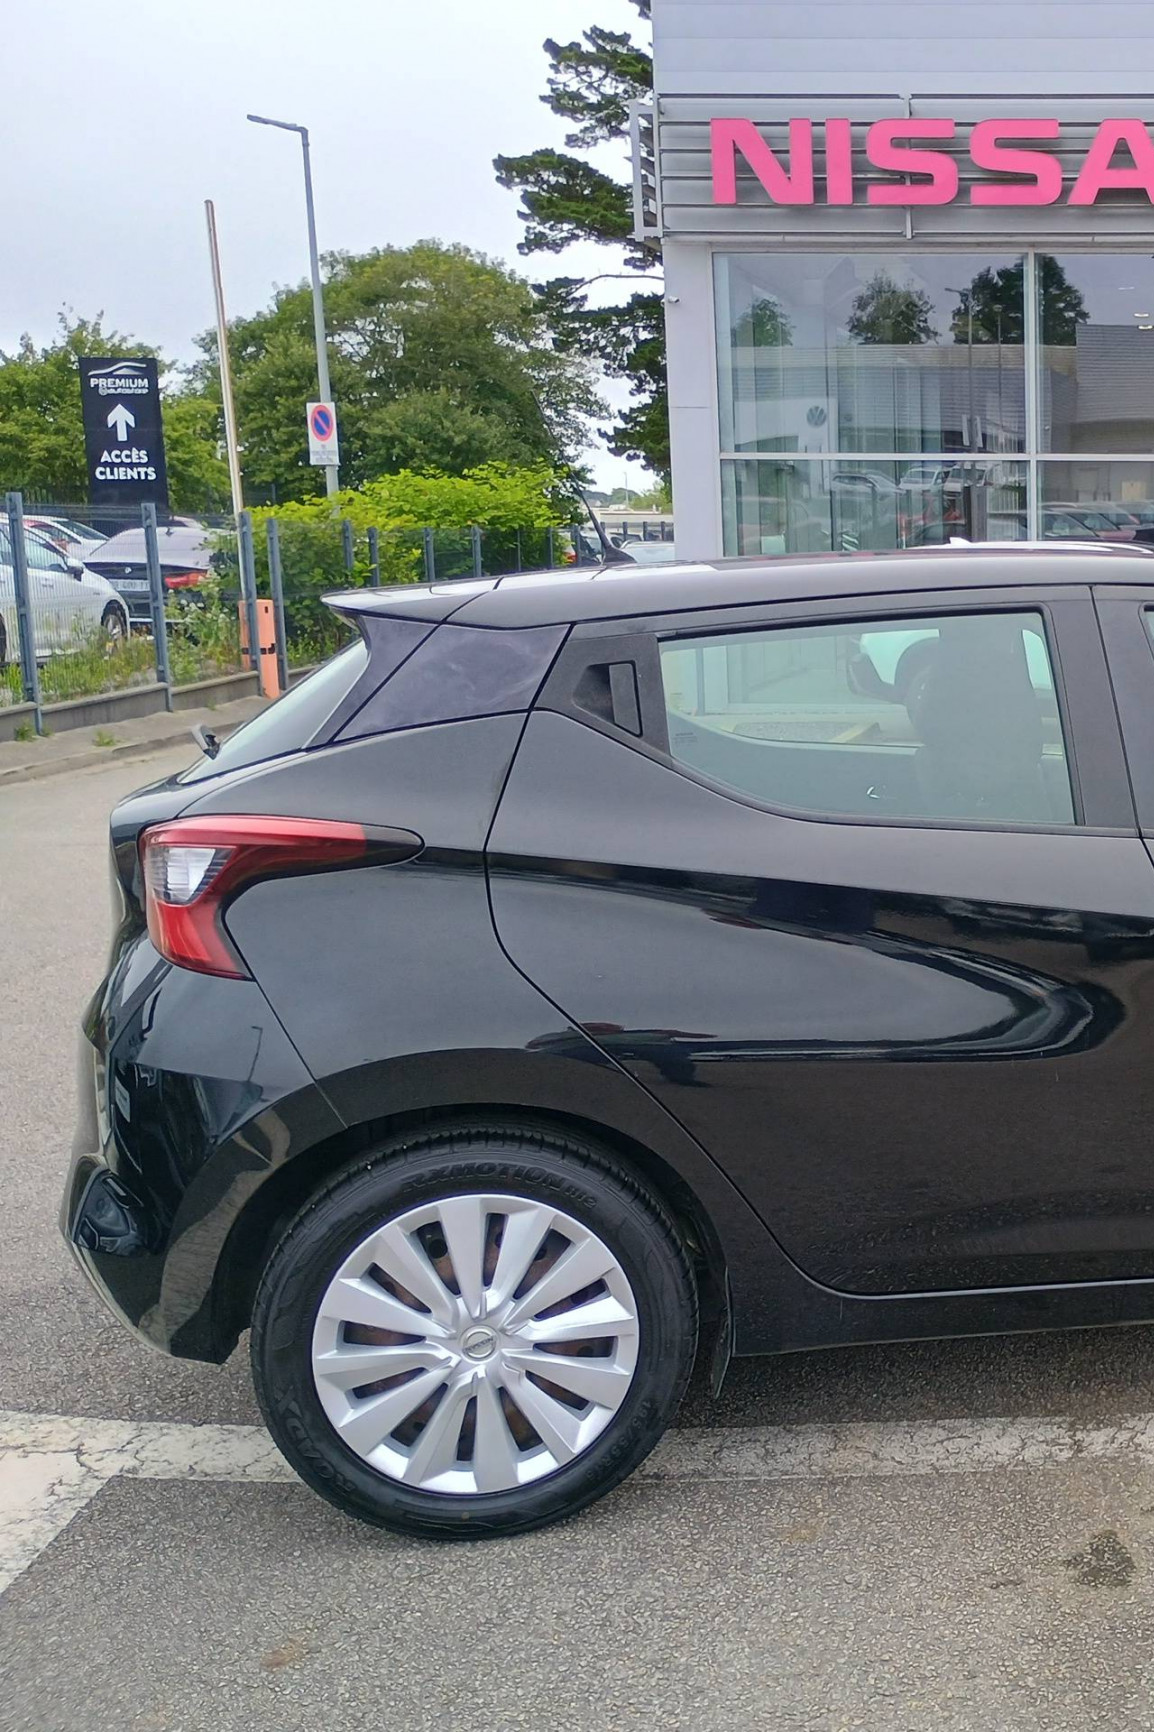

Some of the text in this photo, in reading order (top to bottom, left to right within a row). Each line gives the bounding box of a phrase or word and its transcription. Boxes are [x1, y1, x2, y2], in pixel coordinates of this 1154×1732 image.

[90, 378, 149, 388] PREMIUM
[100, 446, 149, 463] ACCÈS
[95, 467, 157, 480] CLIENTS
